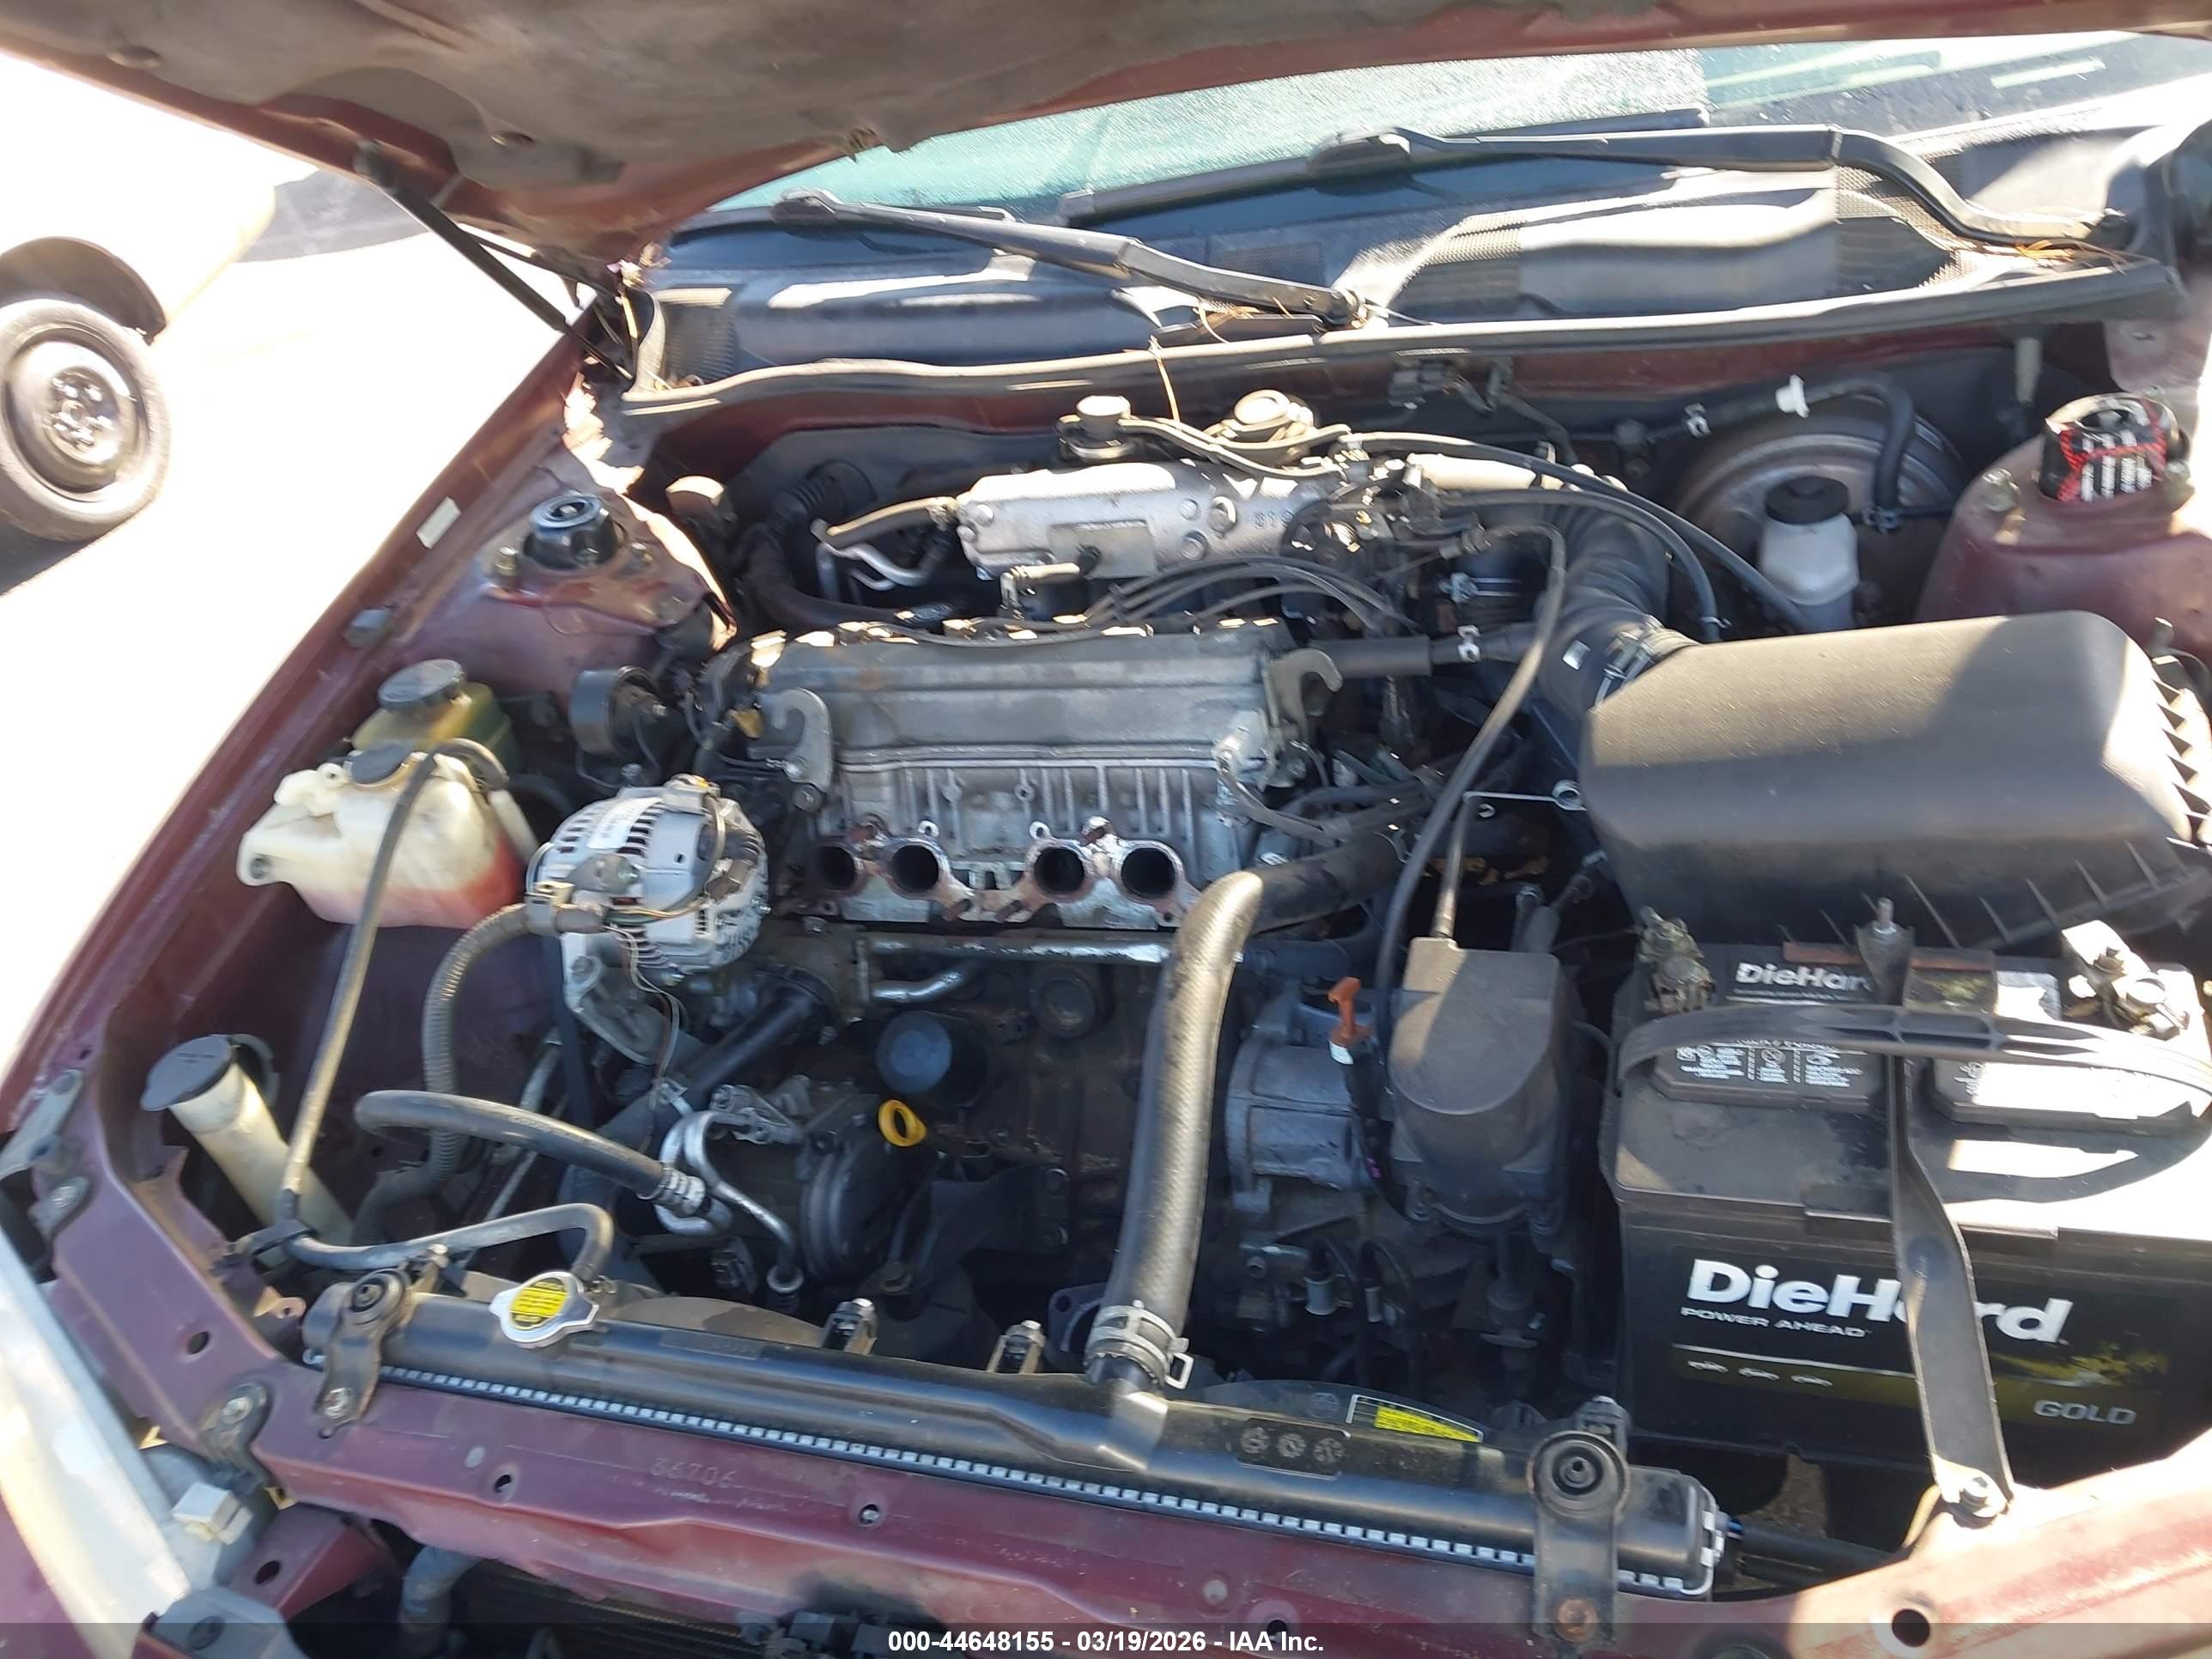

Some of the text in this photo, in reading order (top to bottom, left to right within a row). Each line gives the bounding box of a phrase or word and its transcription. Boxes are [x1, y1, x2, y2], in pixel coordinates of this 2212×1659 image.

[1735, 962, 1873, 991] DieHar
[1687, 1259, 2073, 1343] DieHrd
[1680, 1307, 1867, 1338] POWER AHEAD
[2033, 1400, 2136, 1425] GOLD
